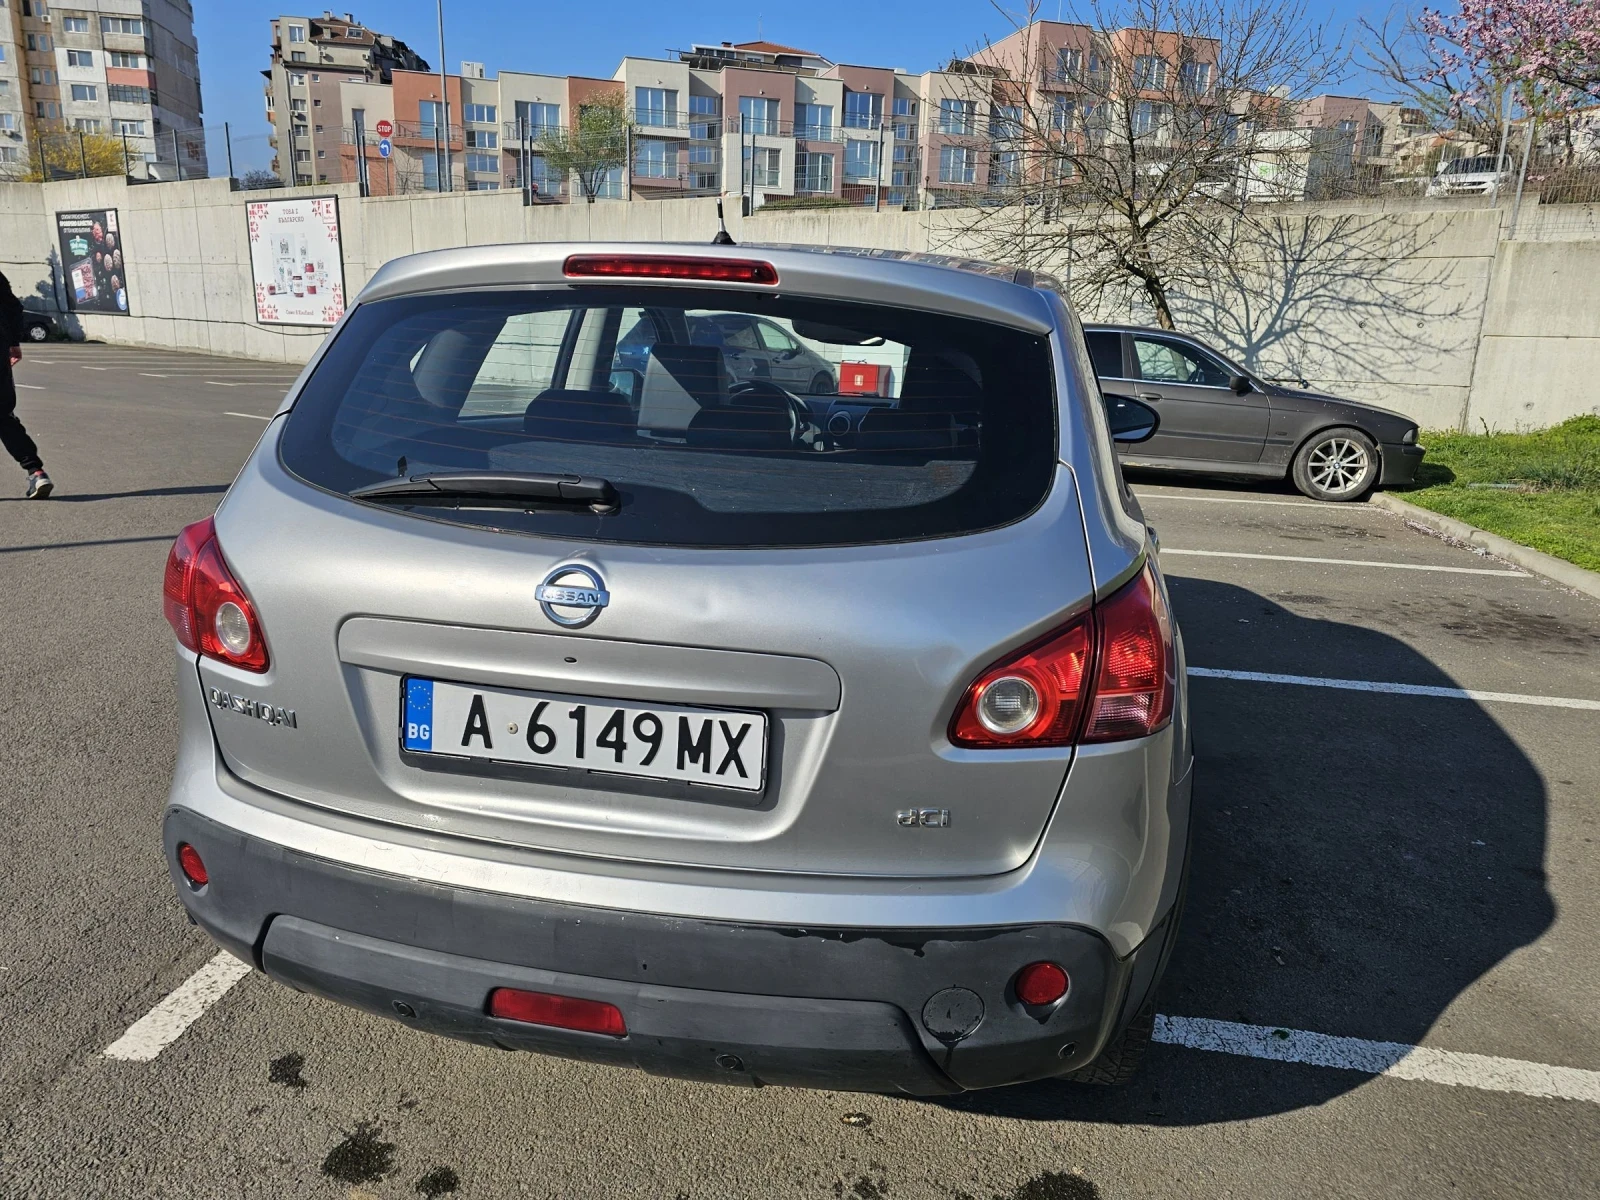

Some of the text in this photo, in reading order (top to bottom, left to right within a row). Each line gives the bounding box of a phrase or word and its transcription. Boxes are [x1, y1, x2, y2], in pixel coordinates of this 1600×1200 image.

[541, 589, 600, 603] NISSAN
[209, 686, 298, 729] QASHQAI
[408, 722, 430, 741] BG
